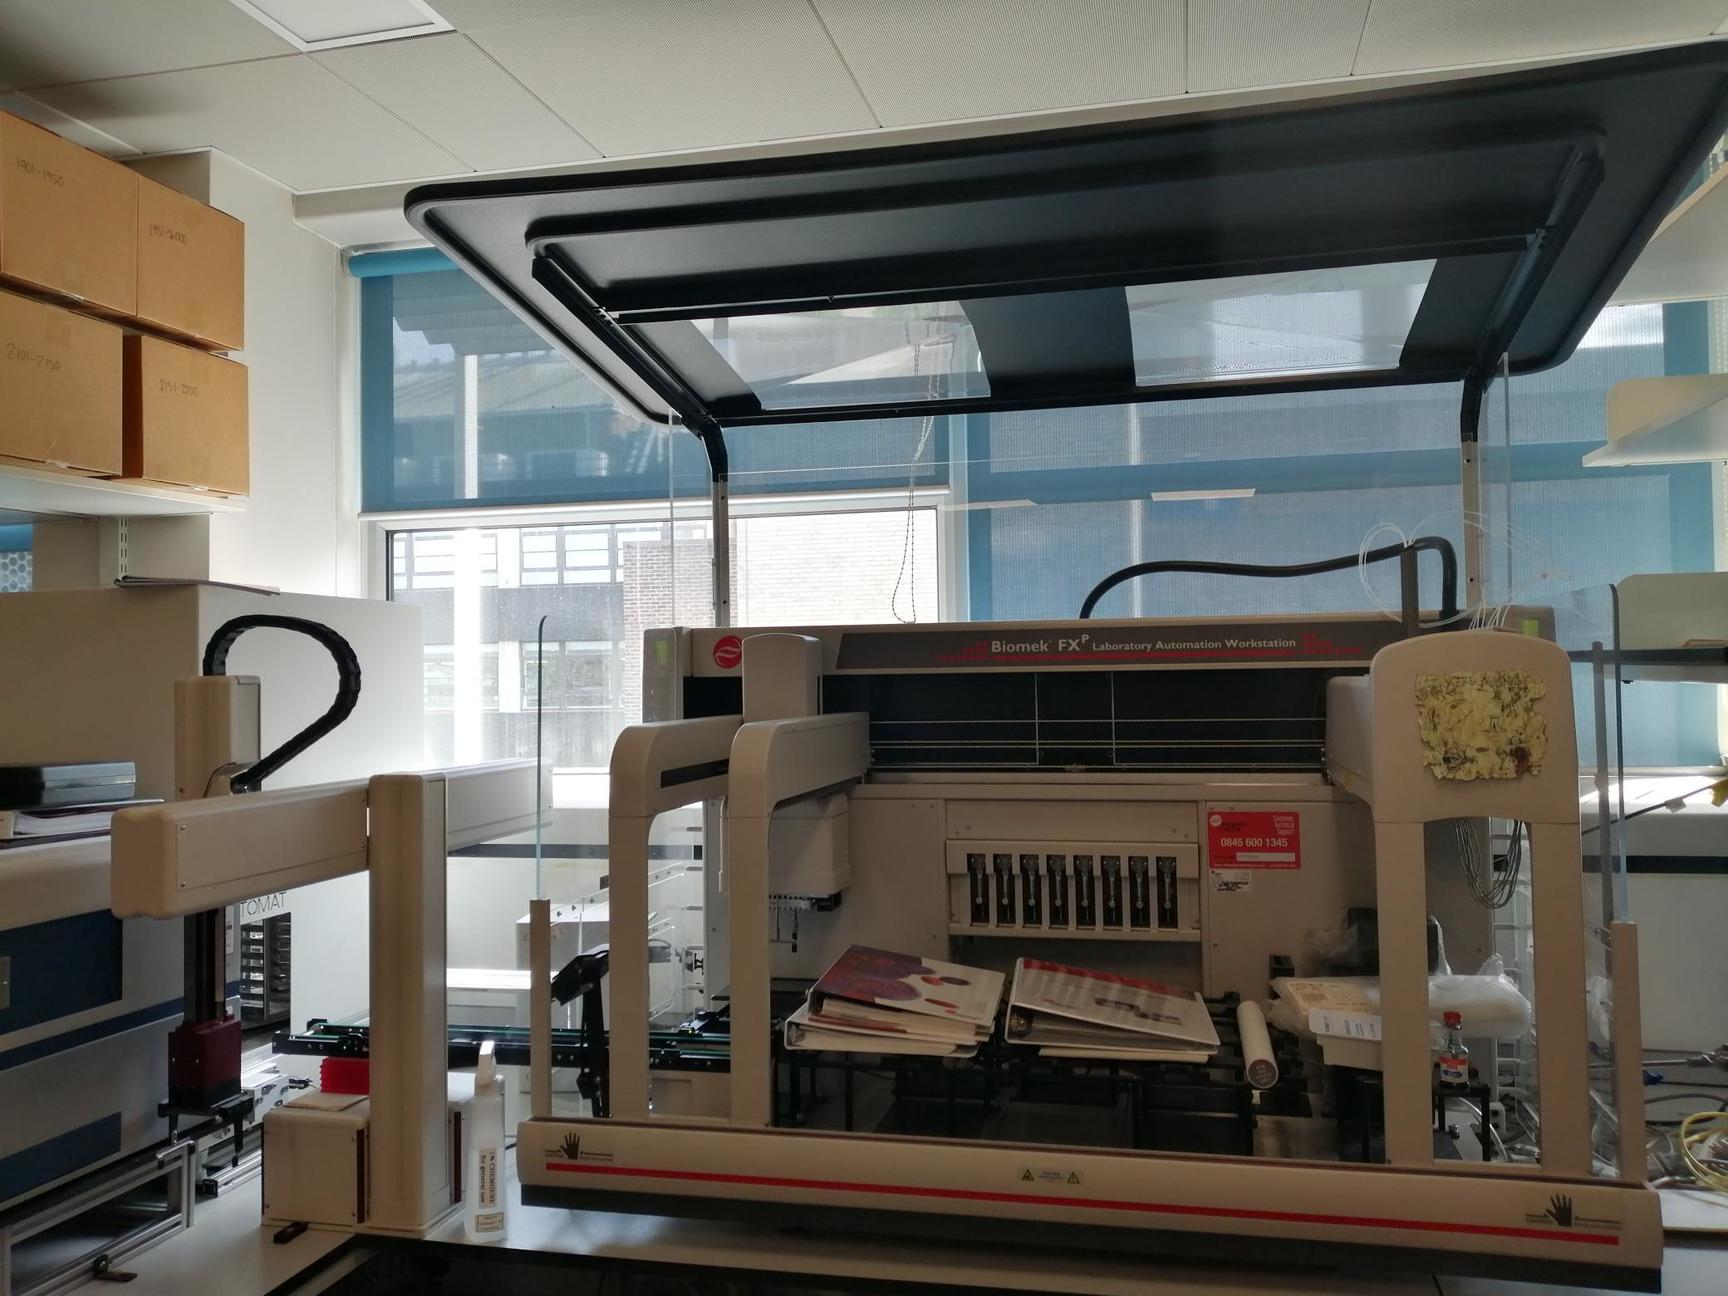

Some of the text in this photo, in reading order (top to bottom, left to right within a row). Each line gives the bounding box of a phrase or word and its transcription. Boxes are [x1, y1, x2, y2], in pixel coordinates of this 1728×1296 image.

[991, 640, 1048, 653] Biomek
[1092, 641, 1152, 654] Laboratory
[1155, 639, 1222, 650] Automation
[1225, 638, 1296, 649] Workstation
[1220, 837, 1288, 848] 0845 600 1345
